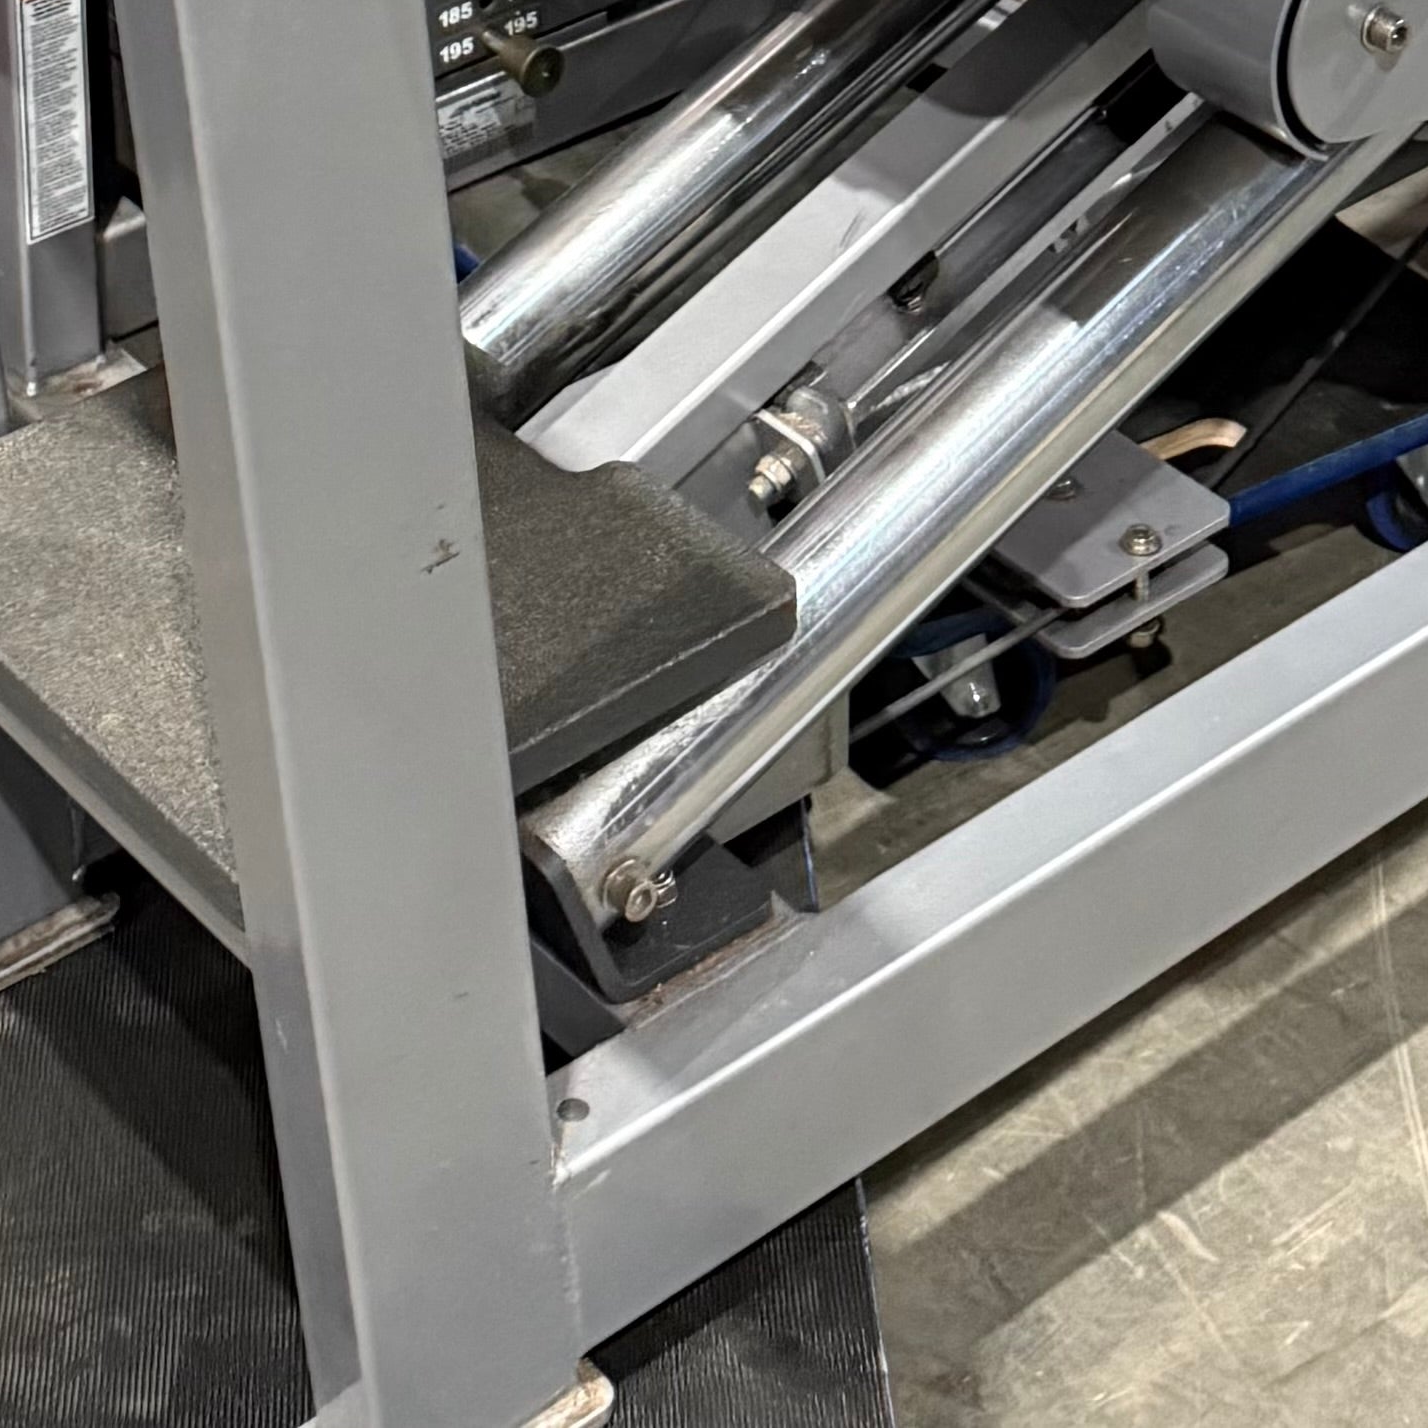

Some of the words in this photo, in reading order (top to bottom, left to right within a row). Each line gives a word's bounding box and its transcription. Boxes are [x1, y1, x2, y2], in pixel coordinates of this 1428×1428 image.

[438, 1, 473, 28] 185
[504, 11, 538, 36] 195
[439, 36, 474, 63] 195
